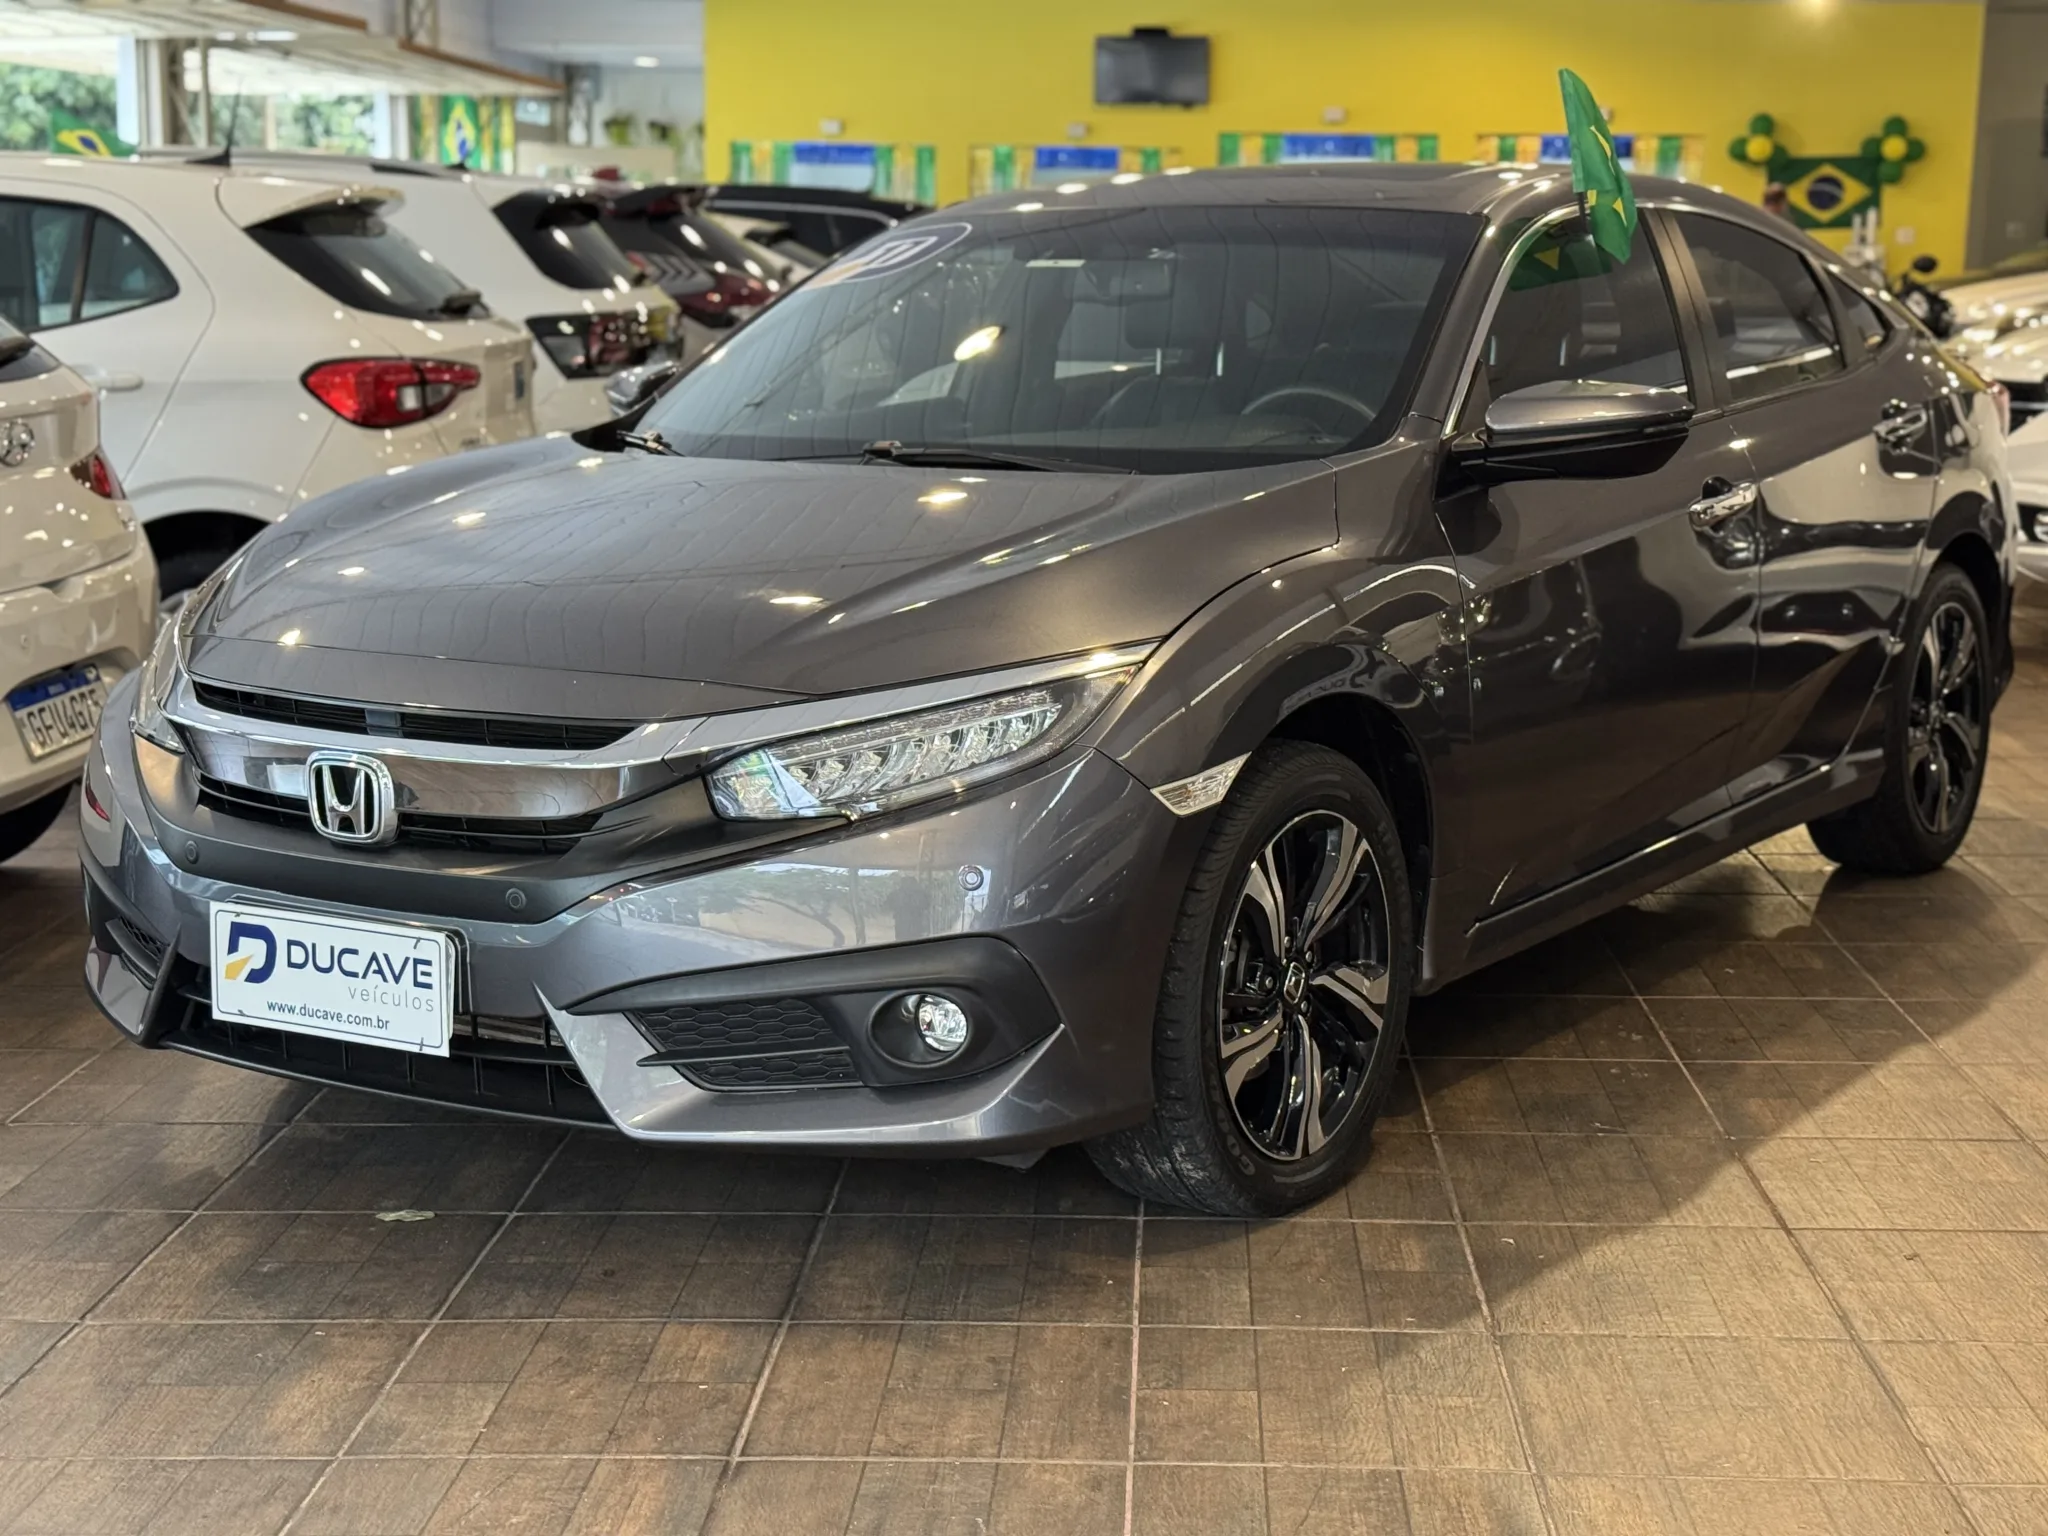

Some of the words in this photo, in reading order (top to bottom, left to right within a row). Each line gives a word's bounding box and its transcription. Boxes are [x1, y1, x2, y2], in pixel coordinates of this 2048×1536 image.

[286, 939, 434, 990] DUCAVE
[348, 985, 434, 1013] veículos
[266, 1000, 390, 1031] www.ducave.com.br
